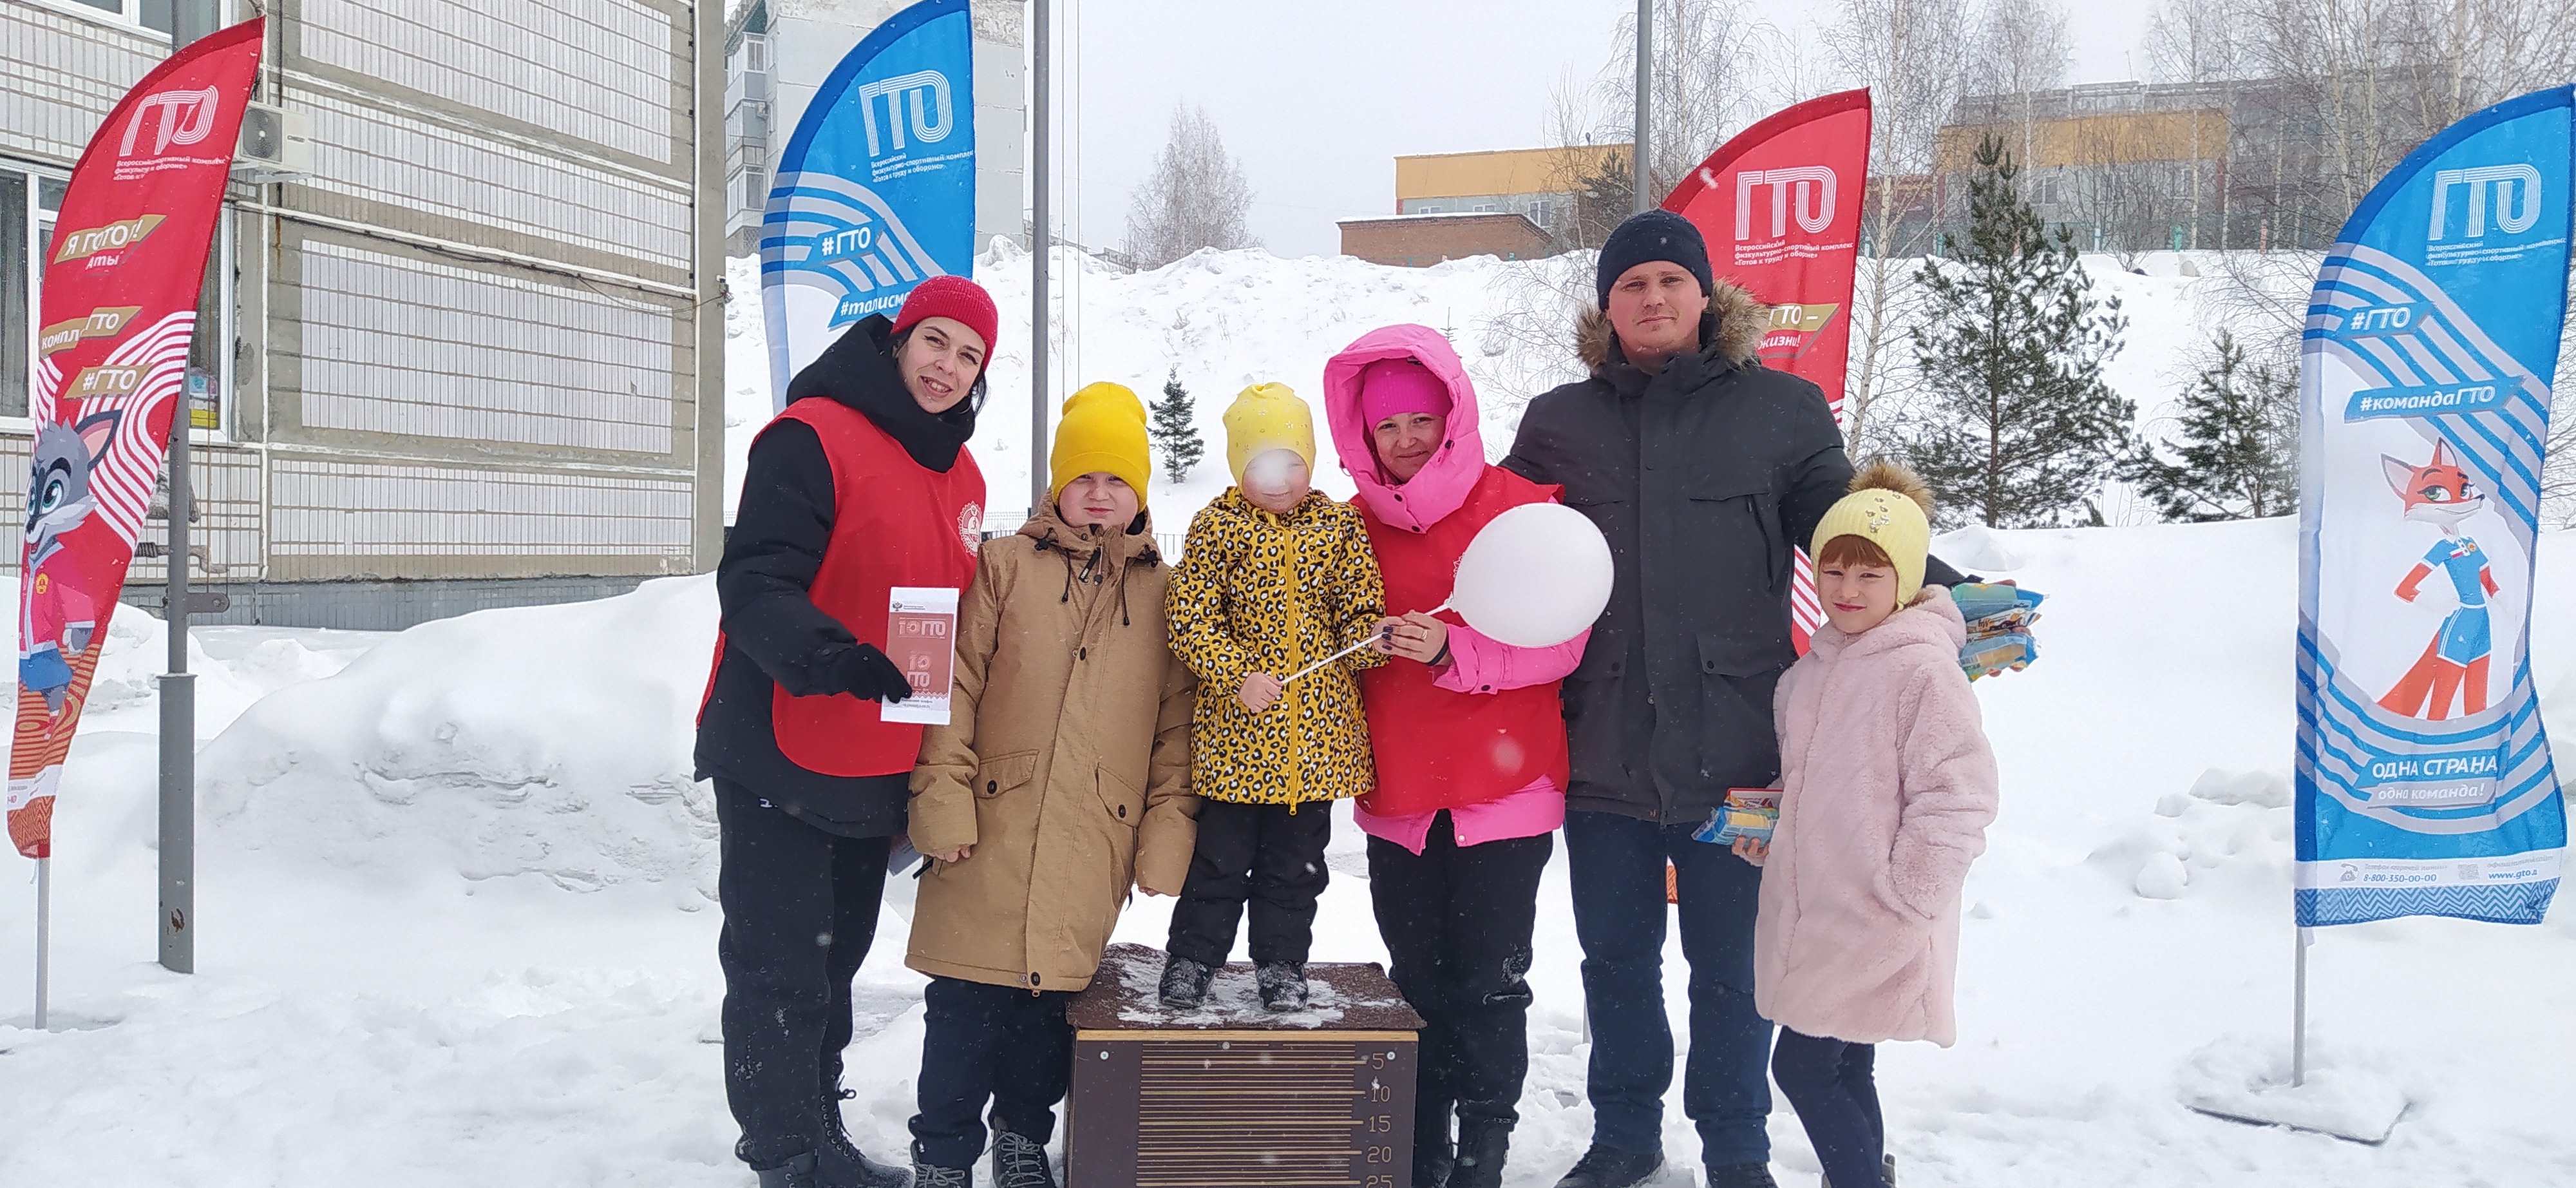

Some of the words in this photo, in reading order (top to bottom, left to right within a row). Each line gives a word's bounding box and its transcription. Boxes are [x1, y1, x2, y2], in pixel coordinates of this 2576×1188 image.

[119, 85, 218, 157] ГТО
[858, 70, 953, 157] ГТО
[1735, 165, 1837, 240] ГТО
[2428, 164, 2541, 240] ГТО
[64, 235, 79, 256] Я
[822, 227, 871, 256] #ГТО
[1735, 239, 1785, 252] Всероссийский
[1821, 242, 1854, 251] комплекс
[1767, 305, 1802, 327] ГТО
[2351, 307, 2410, 330] #ГТО
[82, 369, 137, 391] #ГТО
[2360, 385, 2496, 411] #командаГТО
[2372, 760, 2419, 780] ОДНА
[2423, 755, 2497, 776] СТРАНА
[2378, 787, 2409, 800] одна
[2410, 783, 2485, 800] команда!
[2363, 874, 2437, 883] 8-800-350-00-00
[1372, 1053, 1385, 1070] 5
[1371, 1086, 1390, 1102] 10
[1368, 1115, 1391, 1133] 15
[1367, 1146, 1392, 1163] 20
[1366, 1174, 1393, 1188] 25
